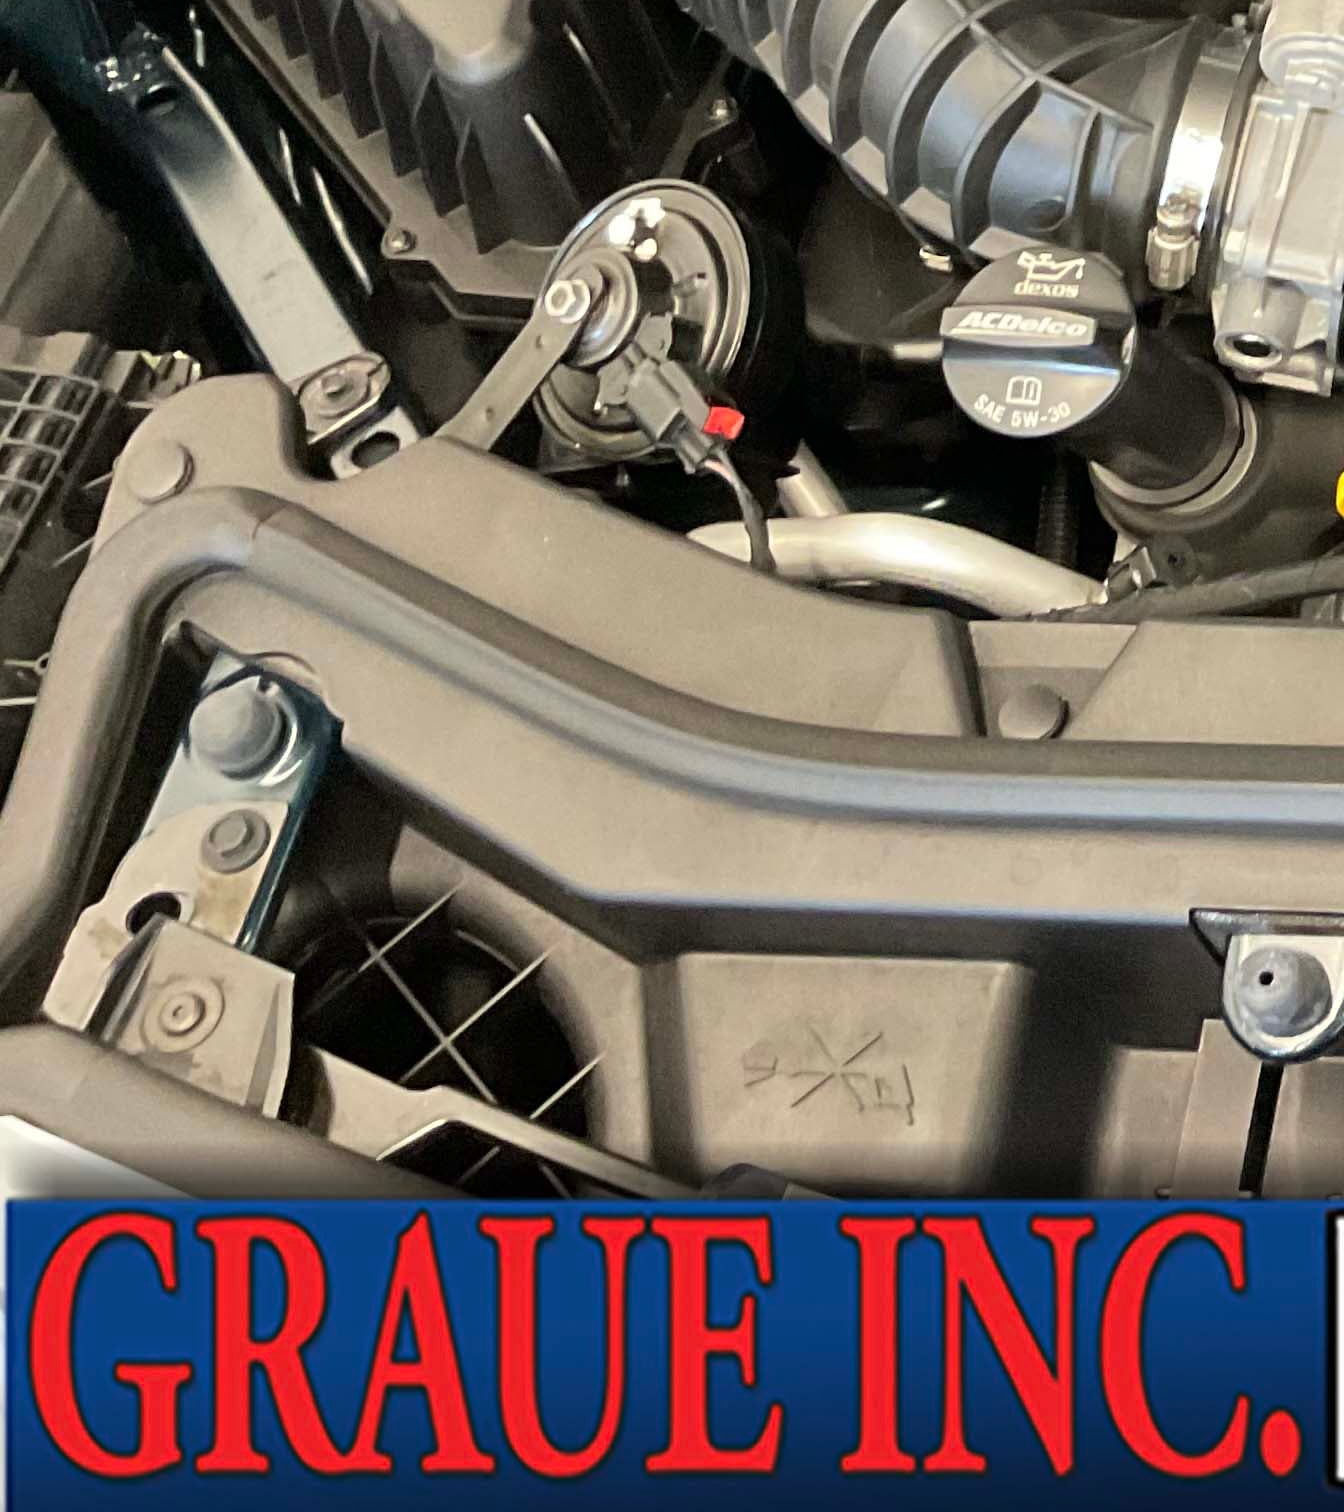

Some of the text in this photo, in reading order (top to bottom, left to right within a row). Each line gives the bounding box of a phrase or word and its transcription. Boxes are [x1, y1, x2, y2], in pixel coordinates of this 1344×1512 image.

[1013, 279, 1080, 298] dexos
[956, 311, 1088, 337] ACDelco
[973, 393, 1072, 428] SAE 5W-30
